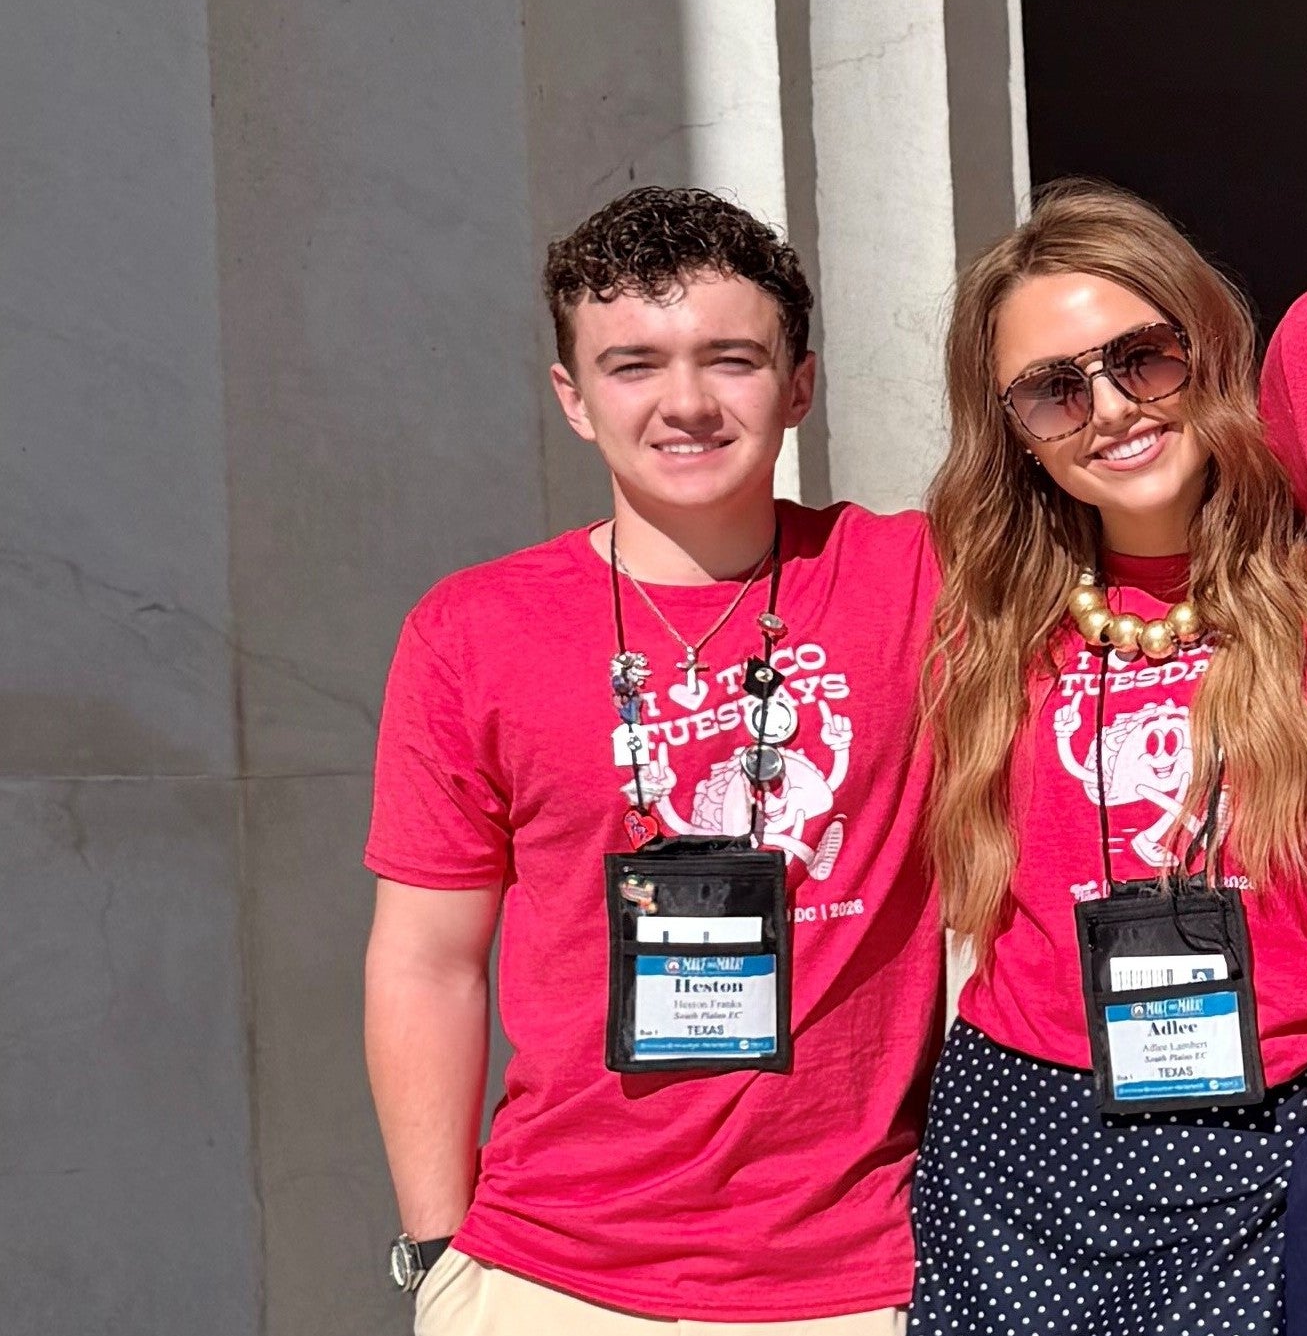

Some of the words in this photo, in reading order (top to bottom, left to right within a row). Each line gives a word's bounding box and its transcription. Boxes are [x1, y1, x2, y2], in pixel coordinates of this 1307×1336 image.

[1077, 651, 1092, 671] I
[643, 691, 661, 717] I
[716, 643, 827, 695] TCO
[1061, 659, 1210, 697] TUESDA
[674, 979, 743, 993] Heston
[687, 1024, 725, 1036] TEXAS
[1147, 1020, 1198, 1037] Adlee
[1158, 1066, 1194, 1078] TEXAS
